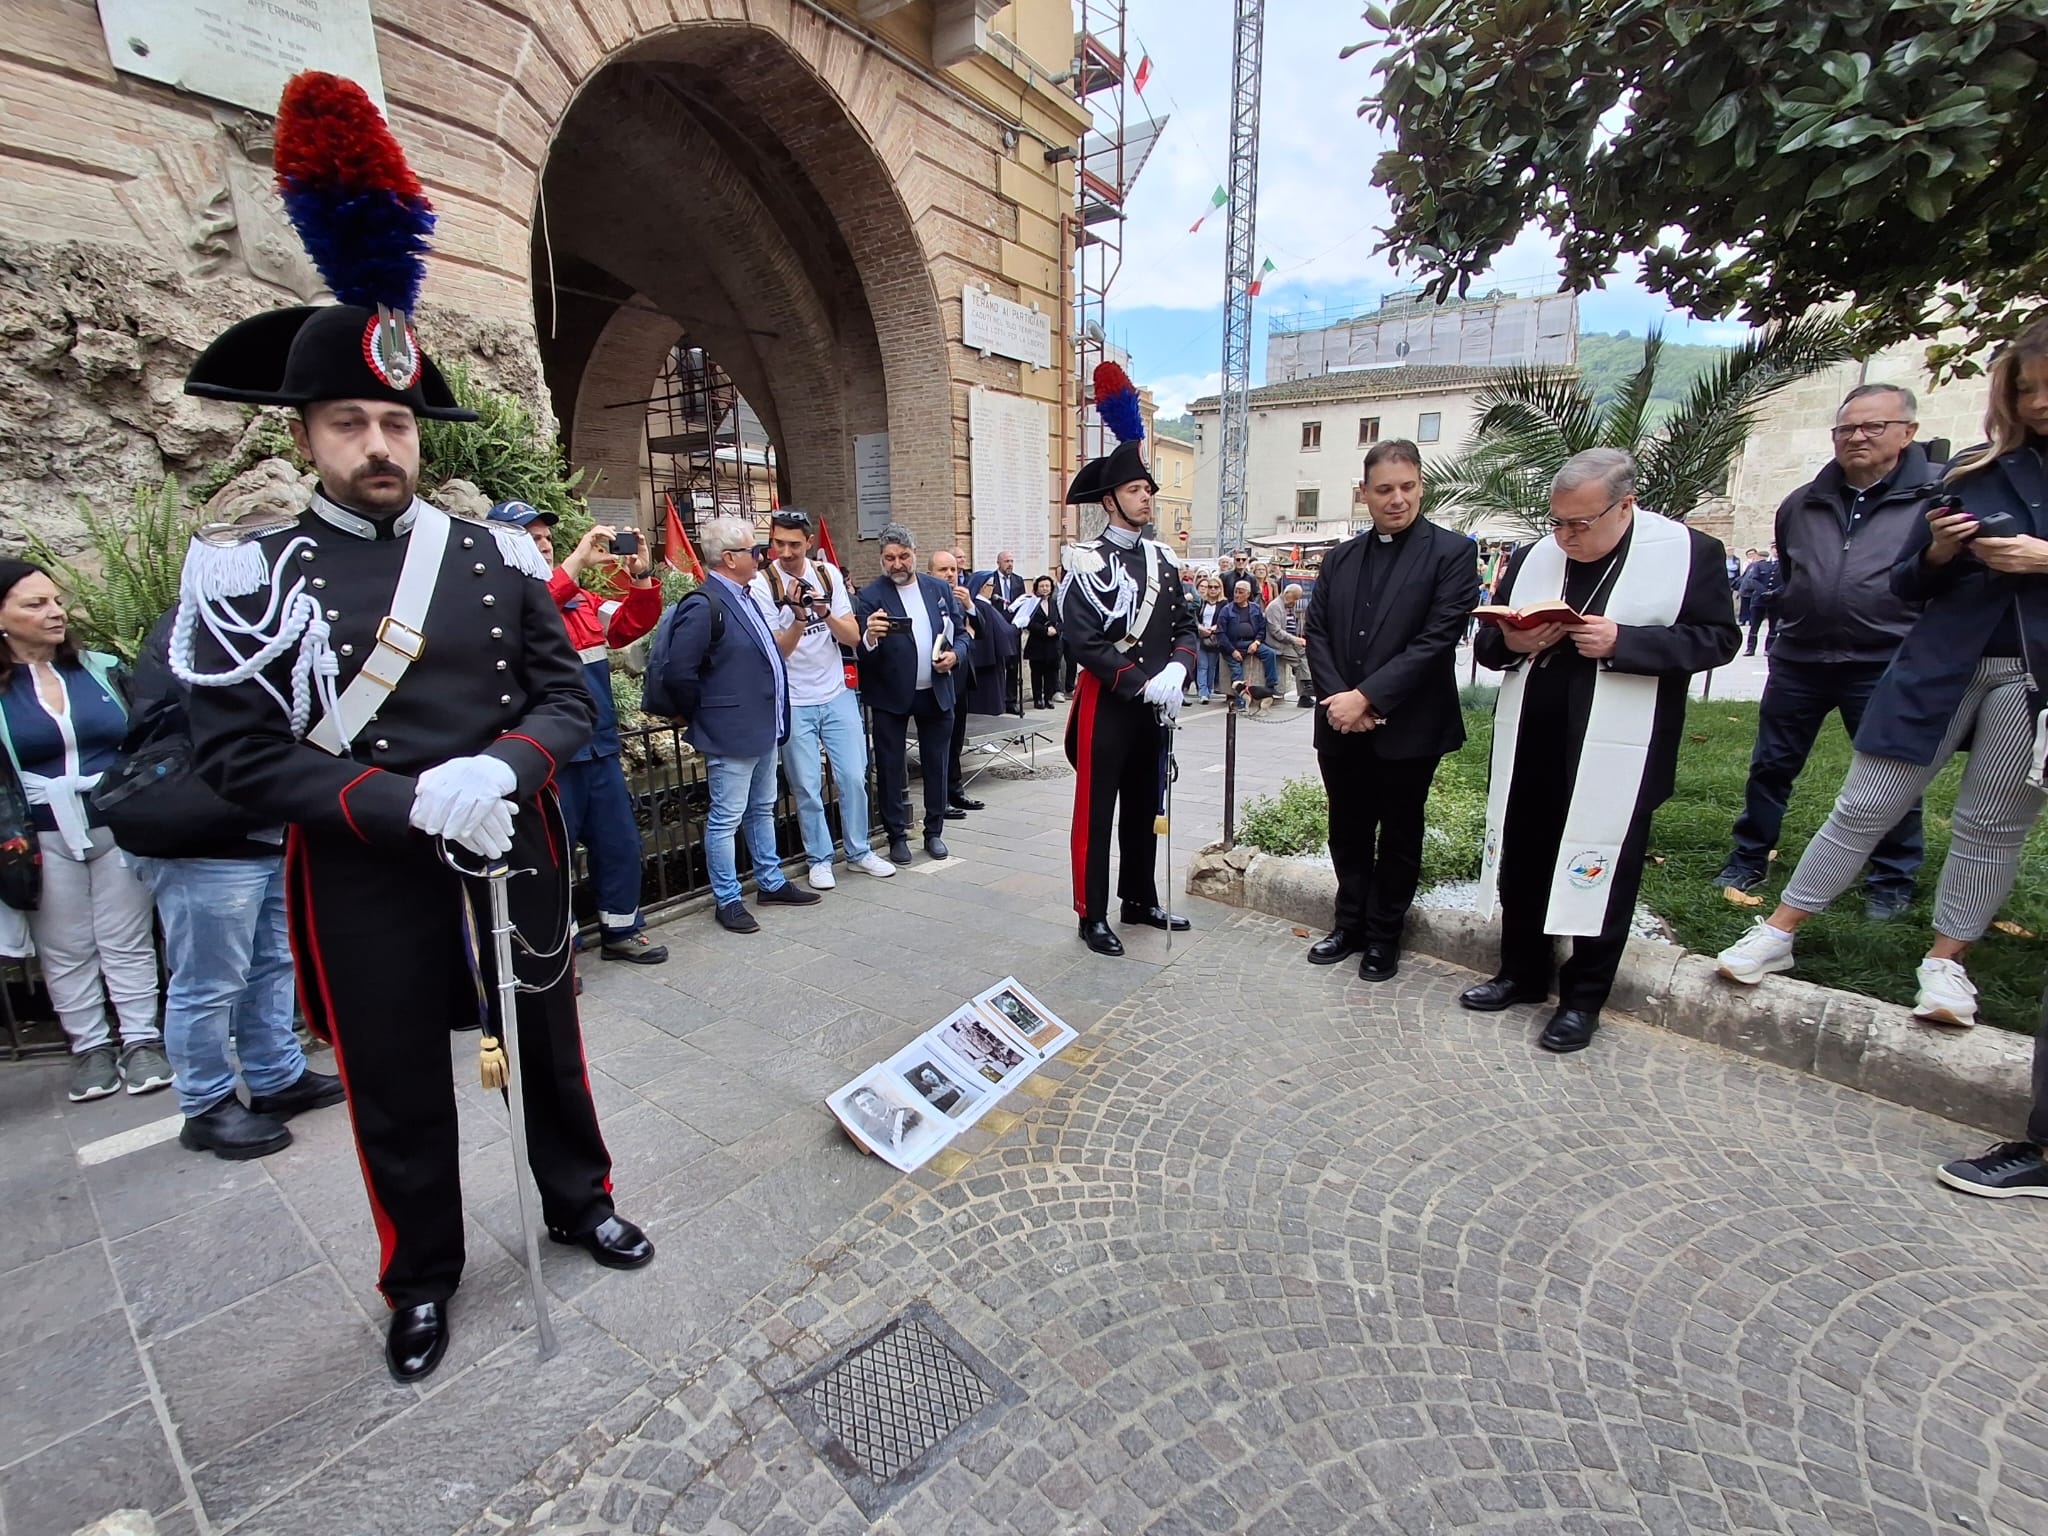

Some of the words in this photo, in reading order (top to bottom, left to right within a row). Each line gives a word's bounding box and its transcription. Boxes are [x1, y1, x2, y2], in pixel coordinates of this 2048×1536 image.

[972, 295, 999, 313] TERAMO
[1003, 306, 1010, 317] AI
[1012, 309, 1046, 329] PARTIGIANI
[972, 310, 992, 322] CADUTI
